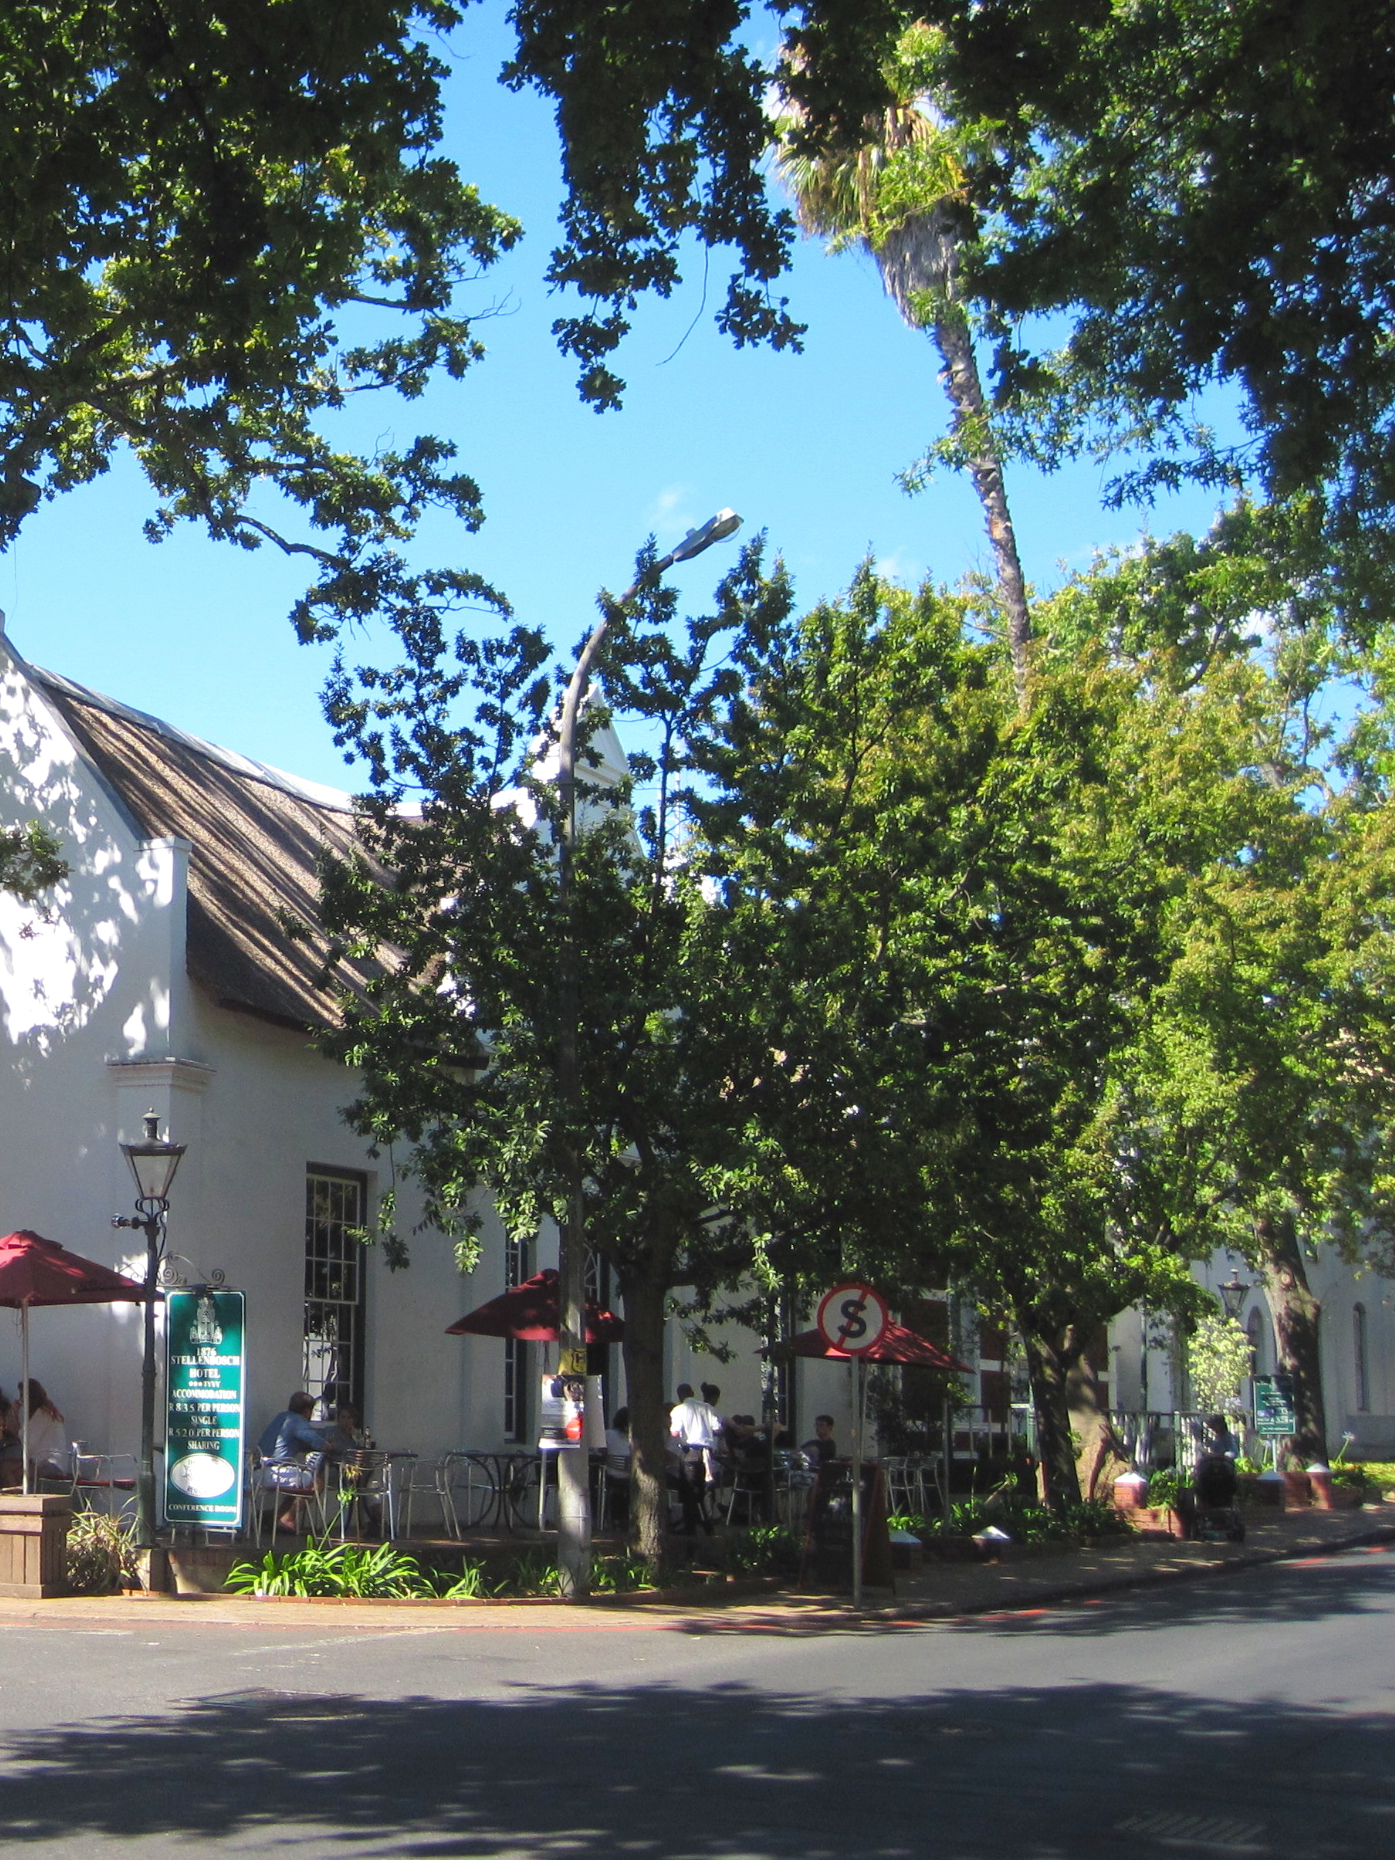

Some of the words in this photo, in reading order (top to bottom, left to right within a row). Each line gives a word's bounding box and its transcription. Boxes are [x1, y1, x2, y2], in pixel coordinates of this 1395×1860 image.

[836, 1299, 867, 1338] S
[196, 1347, 217, 1356] 1876
[170, 1355, 240, 1365] STELLENBOSCH
[189, 1368, 221, 1378] HOTEL
[172, 1389, 237, 1399] ACCOMMODATION
[197, 1403, 212, 1412] PER
[212, 1403, 240, 1413] PERSON
[191, 1415, 218, 1425] SINGLE
[196, 1428, 211, 1437] PER
[212, 1428, 240, 1438] PERSON
[187, 1440, 220, 1450] SHARING
[168, 1504, 213, 1512] CONFERENCE
[214, 1505, 237, 1513] ROOM
